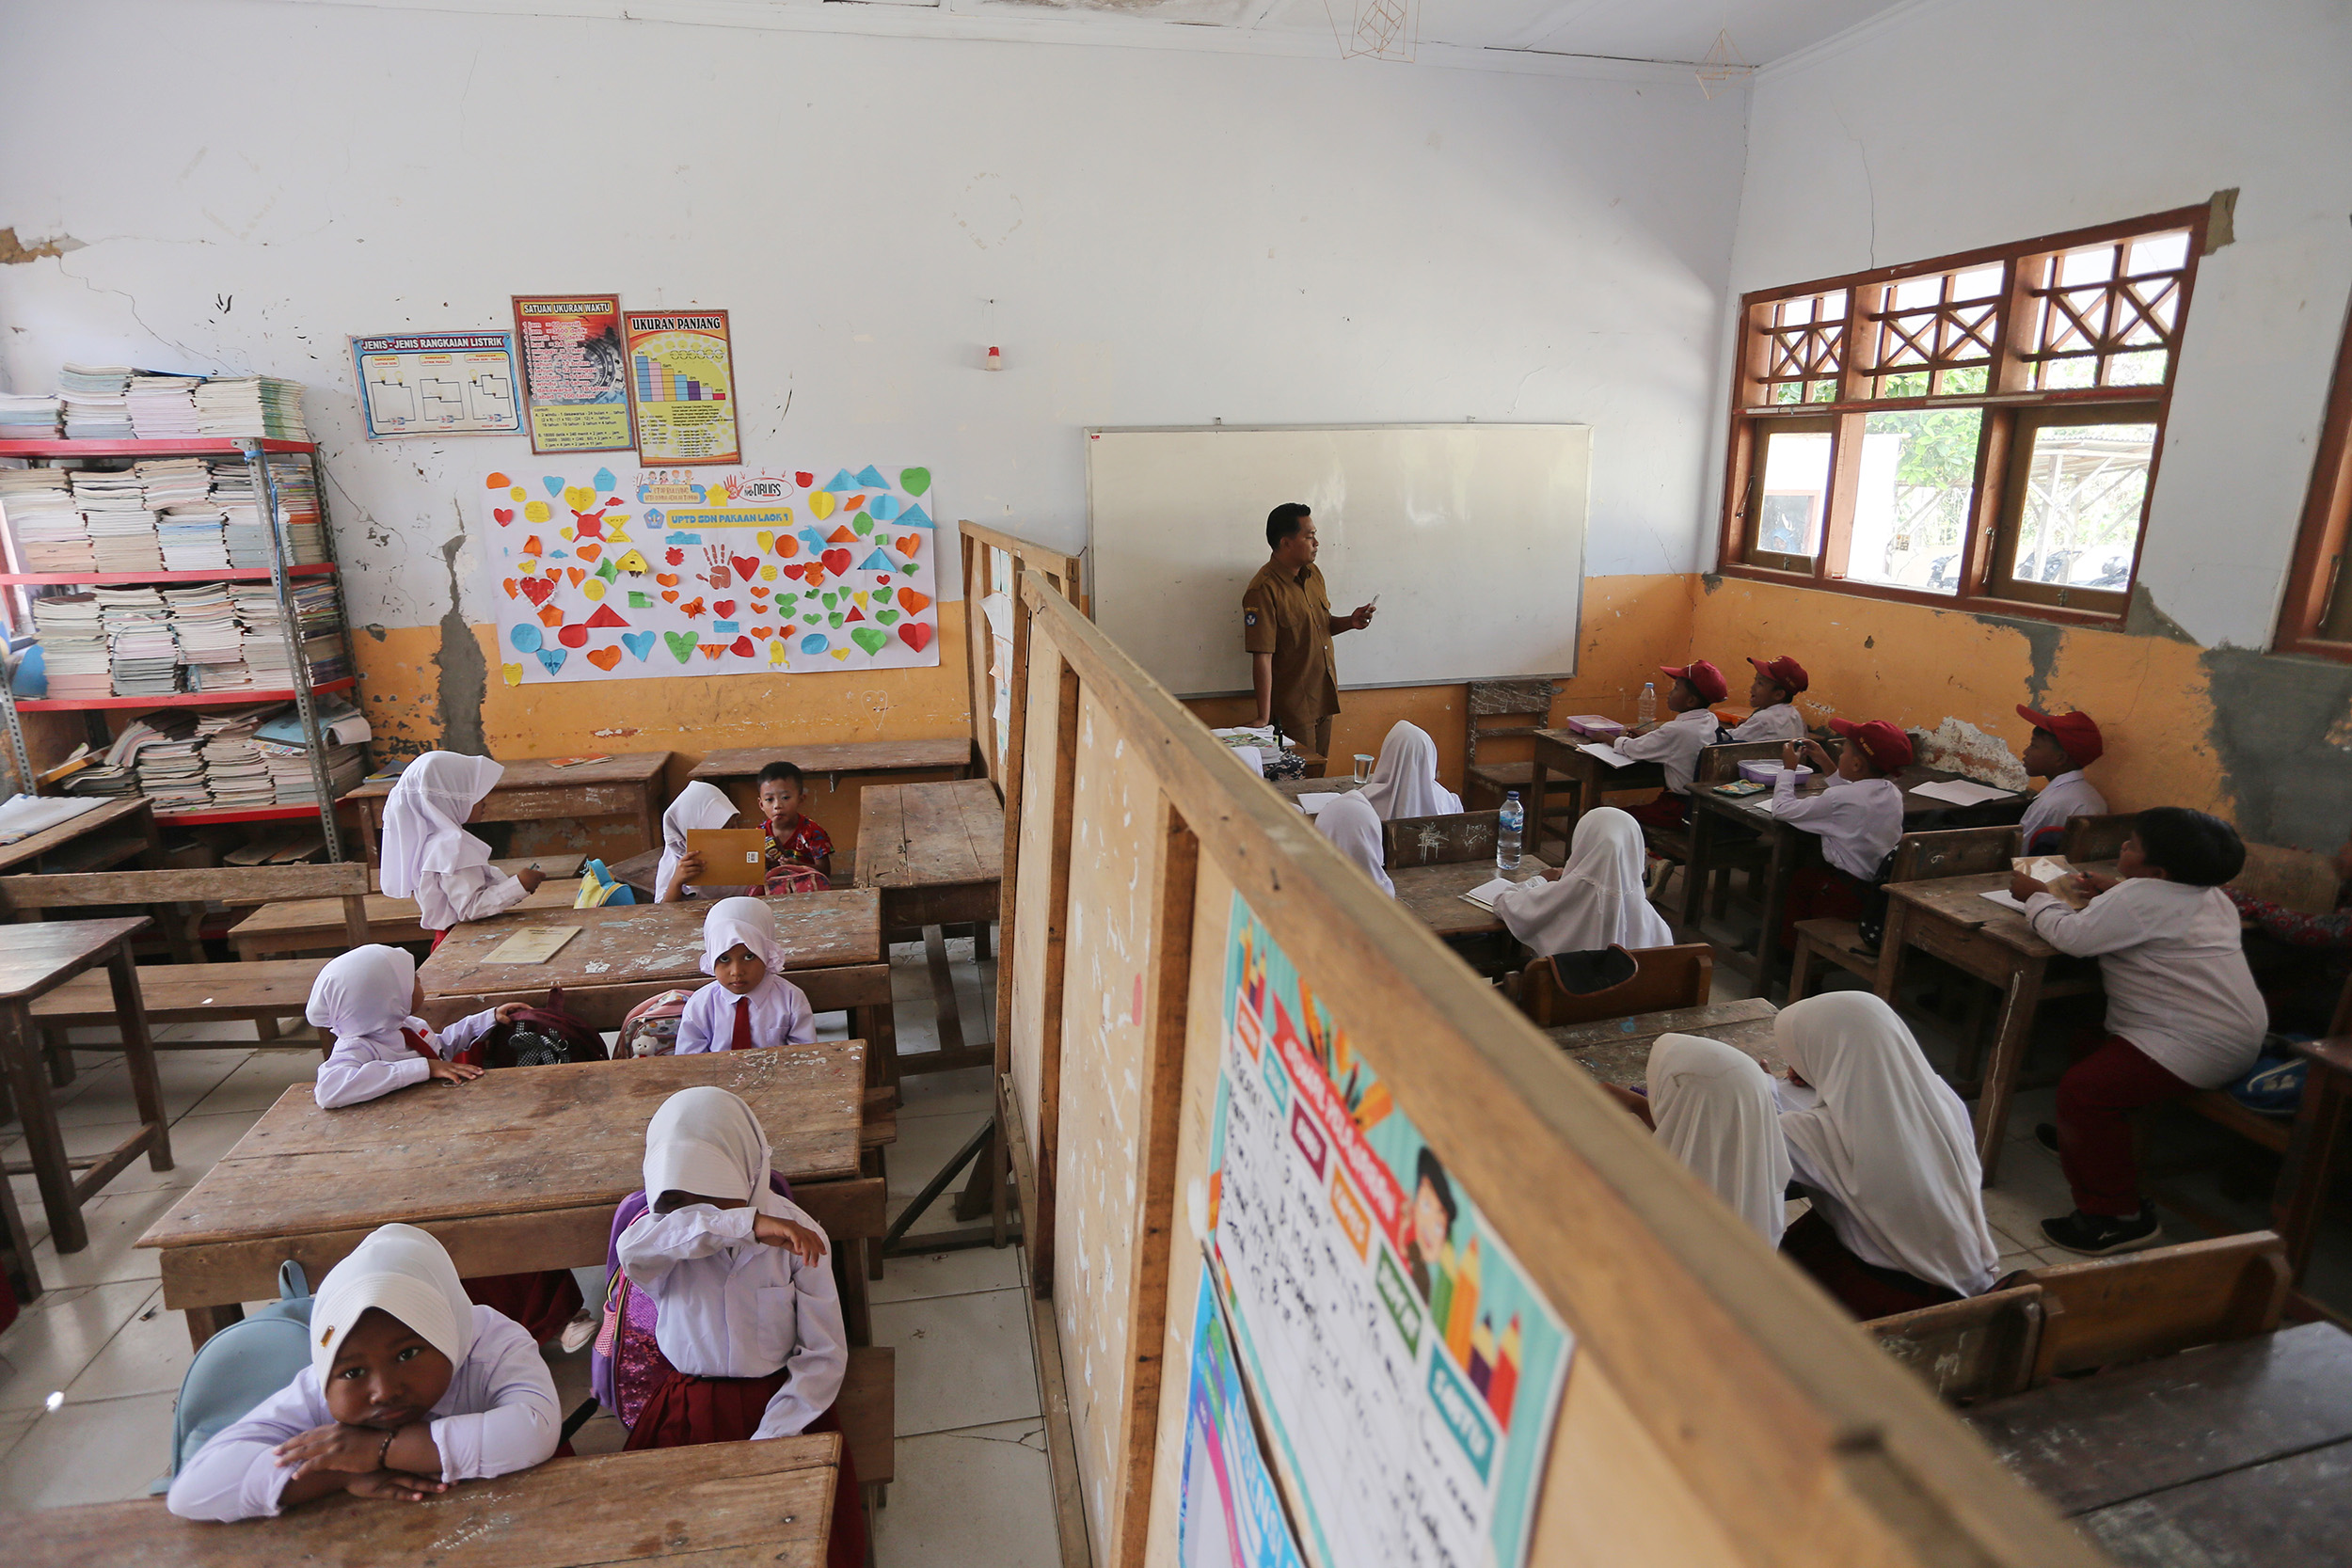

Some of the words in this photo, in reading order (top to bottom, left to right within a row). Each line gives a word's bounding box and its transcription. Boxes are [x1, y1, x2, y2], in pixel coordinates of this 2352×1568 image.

[524, 305, 552, 313] SATUAN
[553, 304, 583, 312] UKURAN
[584, 303, 610, 312] WAKTU
[632, 319, 675, 330] UKURAN
[677, 318, 721, 329] PANJANG
[362, 340, 388, 350] JENIS
[394, 339, 419, 349] JENIS
[420, 338, 469, 348] RANGKAIAN
[470, 338, 502, 347] LISTRIK
[754, 482, 781, 497] DRUGS
[672, 515, 696, 524] UPTD
[719, 514, 756, 523] PAKAAN
[758, 514, 783, 522] LAOK
